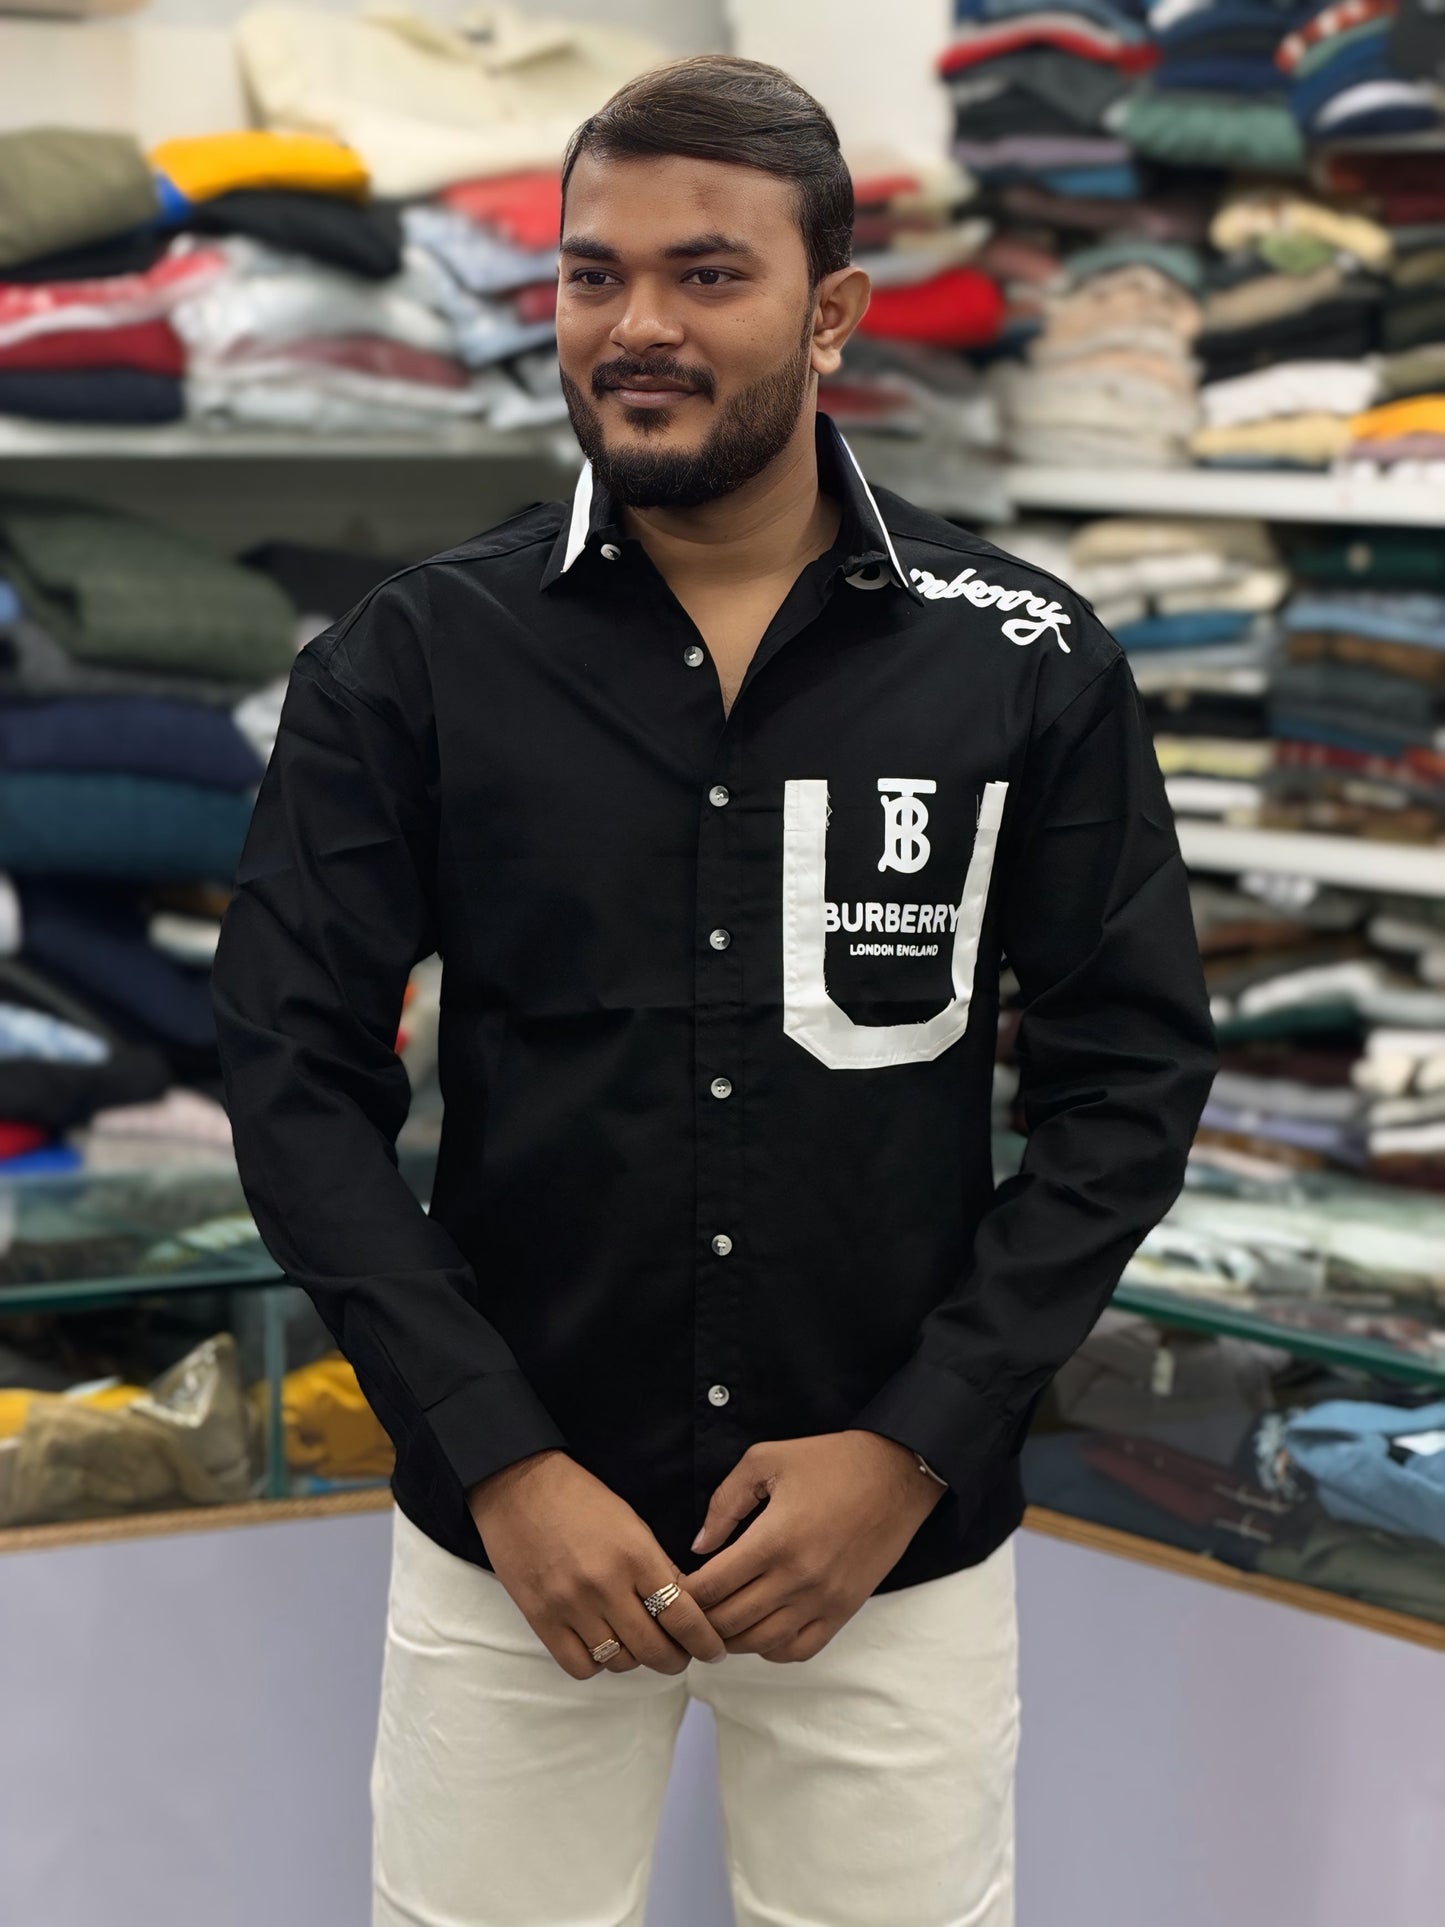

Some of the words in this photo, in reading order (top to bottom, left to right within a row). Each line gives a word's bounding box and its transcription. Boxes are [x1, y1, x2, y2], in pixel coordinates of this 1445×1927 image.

[825, 902, 961, 933] BURBERRY
[850, 943, 894, 956] LONDON
[896, 944, 939, 957] ENGLAND
